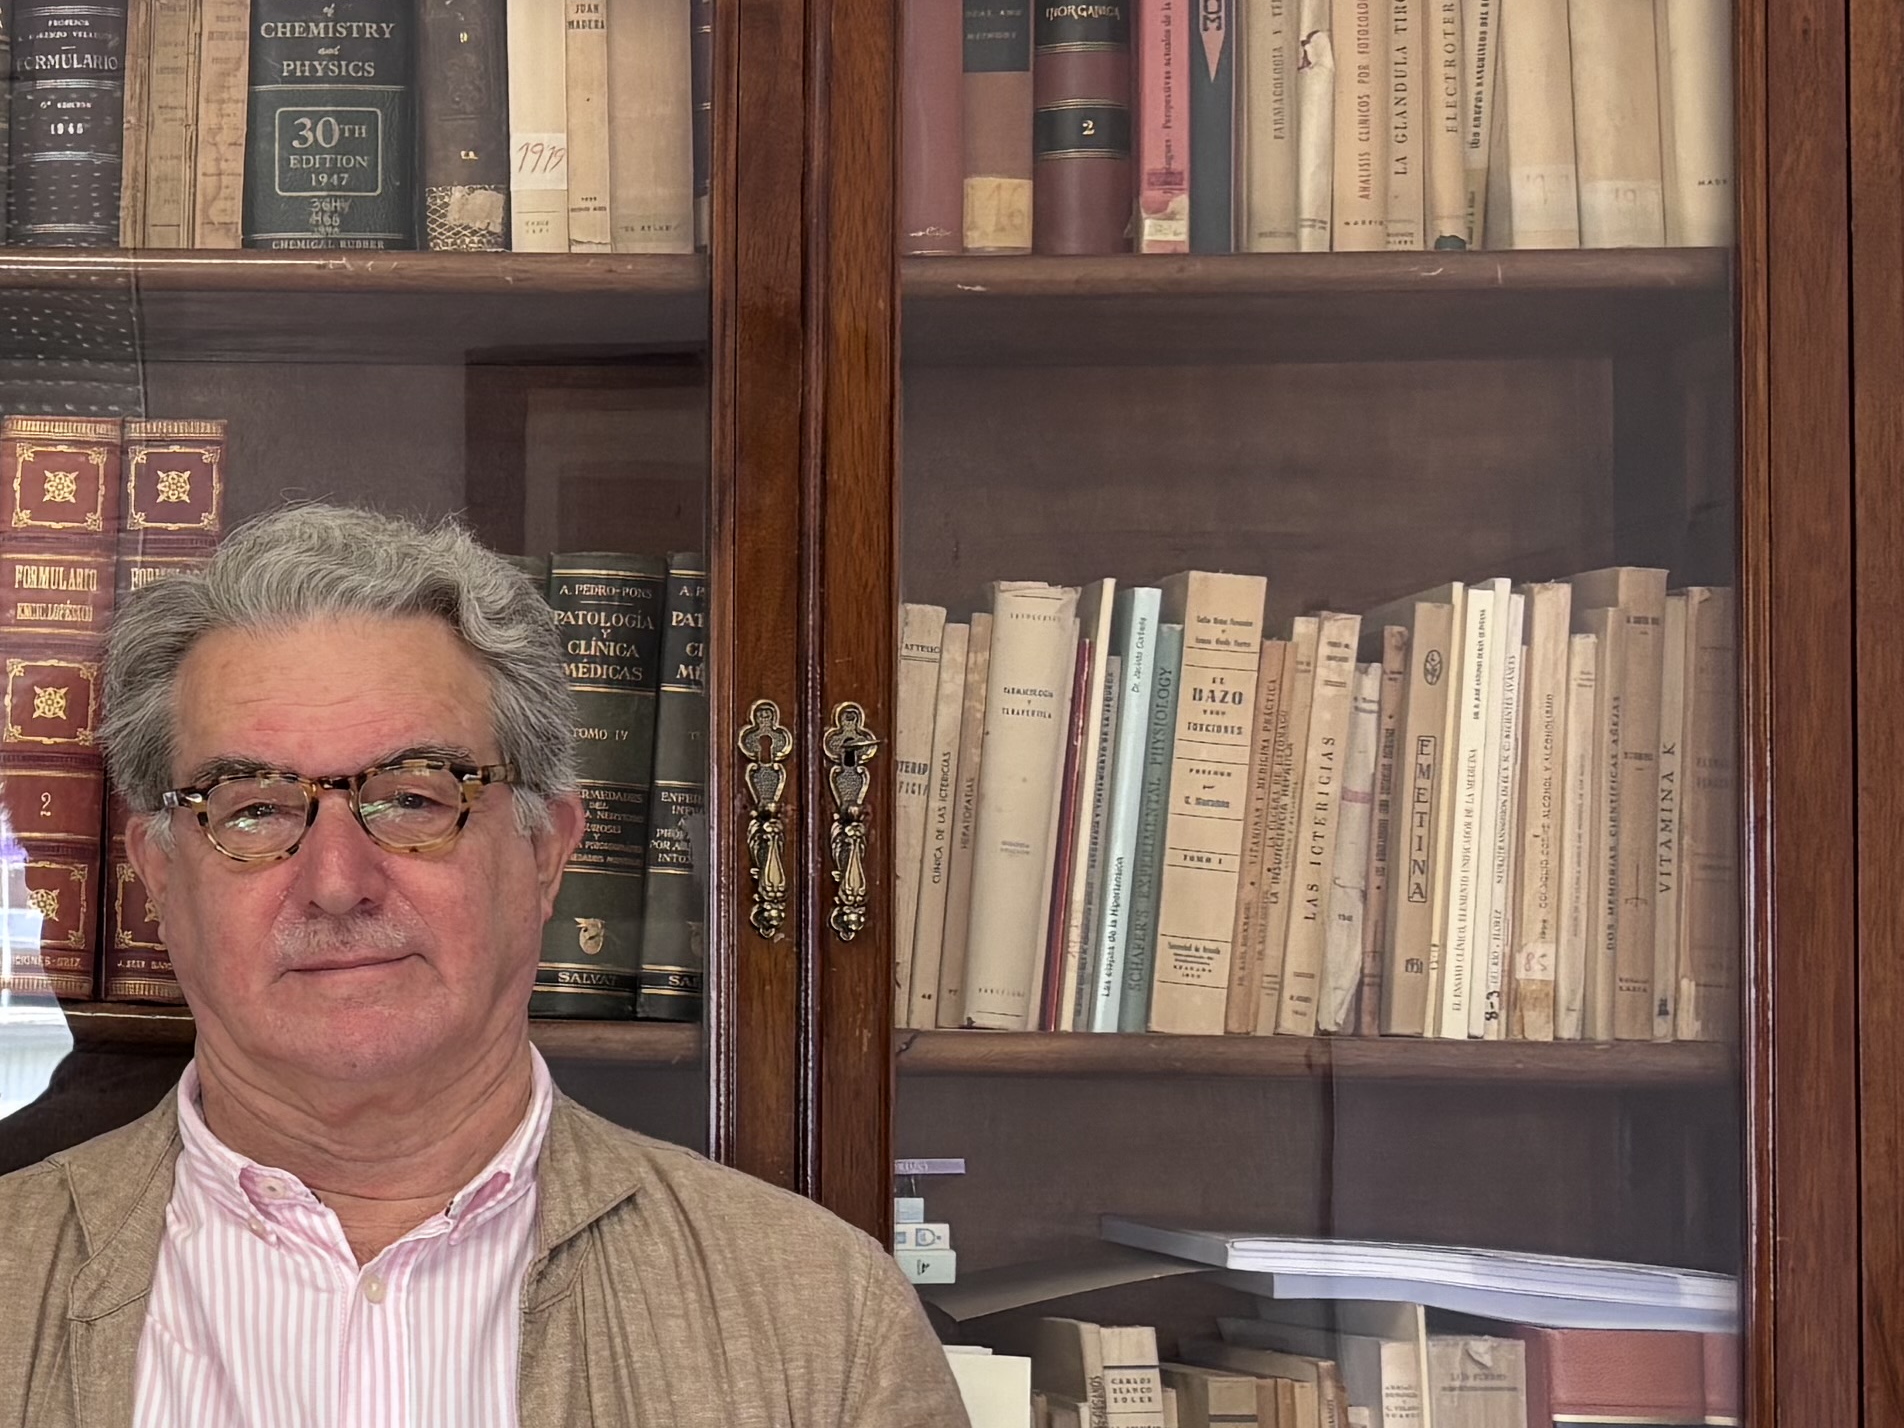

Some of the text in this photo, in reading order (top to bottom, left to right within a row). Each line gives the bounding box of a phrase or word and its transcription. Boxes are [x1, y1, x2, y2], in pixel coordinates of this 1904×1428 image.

[323, 3, 336, 17] of
[260, 22, 395, 38] CHEMISTRY
[317, 45, 341, 56] and
[17, 53, 118, 72] FORMULARIO
[282, 60, 375, 77] PHYSICS
[1357, 64, 1370, 84] POR
[1393, 45, 1408, 144] GLANDULA
[1082, 120, 1094, 135] 2
[1357, 94, 1371, 142] CLINICOS
[289, 155, 369, 168] EDITION
[1393, 155, 1408, 176] LA
[310, 173, 349, 186] 1947
[1357, 152, 1372, 200] ANALISIS
[272, 239, 336, 250] CHEMICAL
[14, 564, 97, 591] FORMULARIO
[559, 584, 652, 599] A. PEDRO-PONS
[553, 610, 655, 630] PATOLOGÍA
[567, 637, 640, 658] CLÍNICA
[562, 662, 643, 682] MÉDICAS
[1192, 688, 1243, 706] BAZO
[1134, 777, 1162, 900] EXPERIMENTAL
[1150, 667, 1173, 766] PHYSIOLOGY
[1410, 738, 1434, 901] EMETINA
[1658, 742, 1676, 894] VITAMINA K
[1303, 736, 1335, 921] LAS ICTERICIAS
